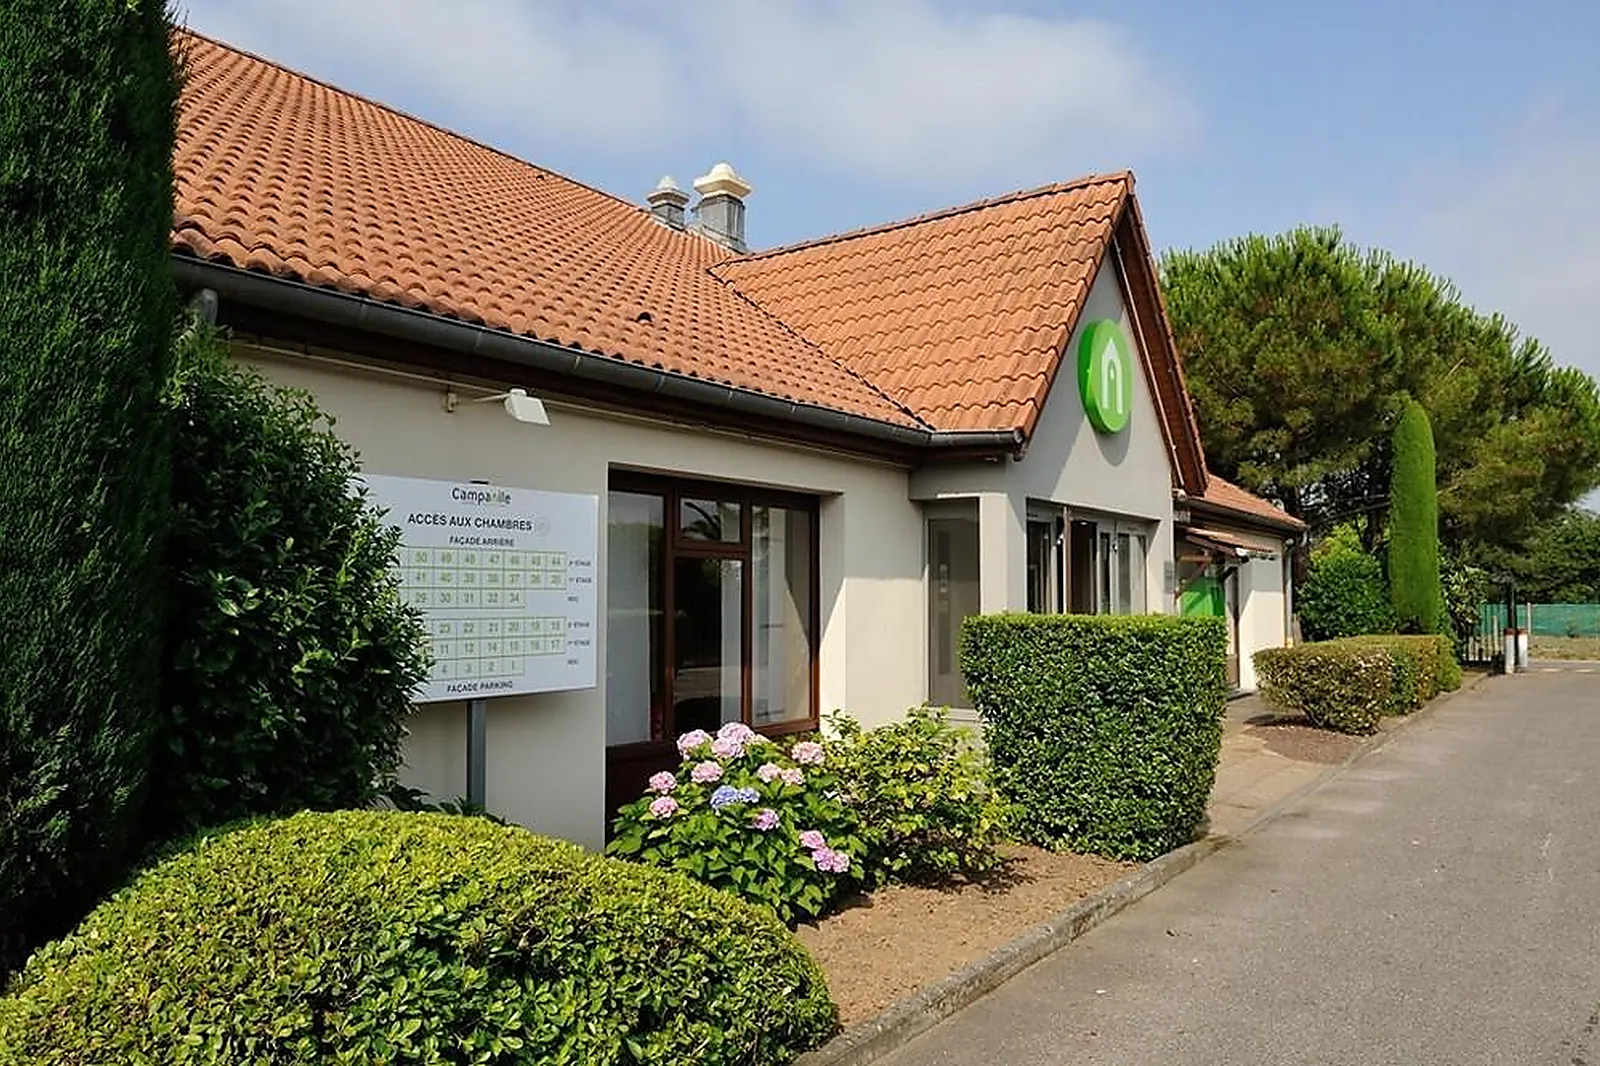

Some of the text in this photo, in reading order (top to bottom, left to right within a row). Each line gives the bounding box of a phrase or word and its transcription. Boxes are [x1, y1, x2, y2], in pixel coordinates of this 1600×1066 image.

[449, 516, 471, 527] AUX
[474, 517, 533, 531] CHAMBRES
[447, 682, 478, 693] FAÇADE
